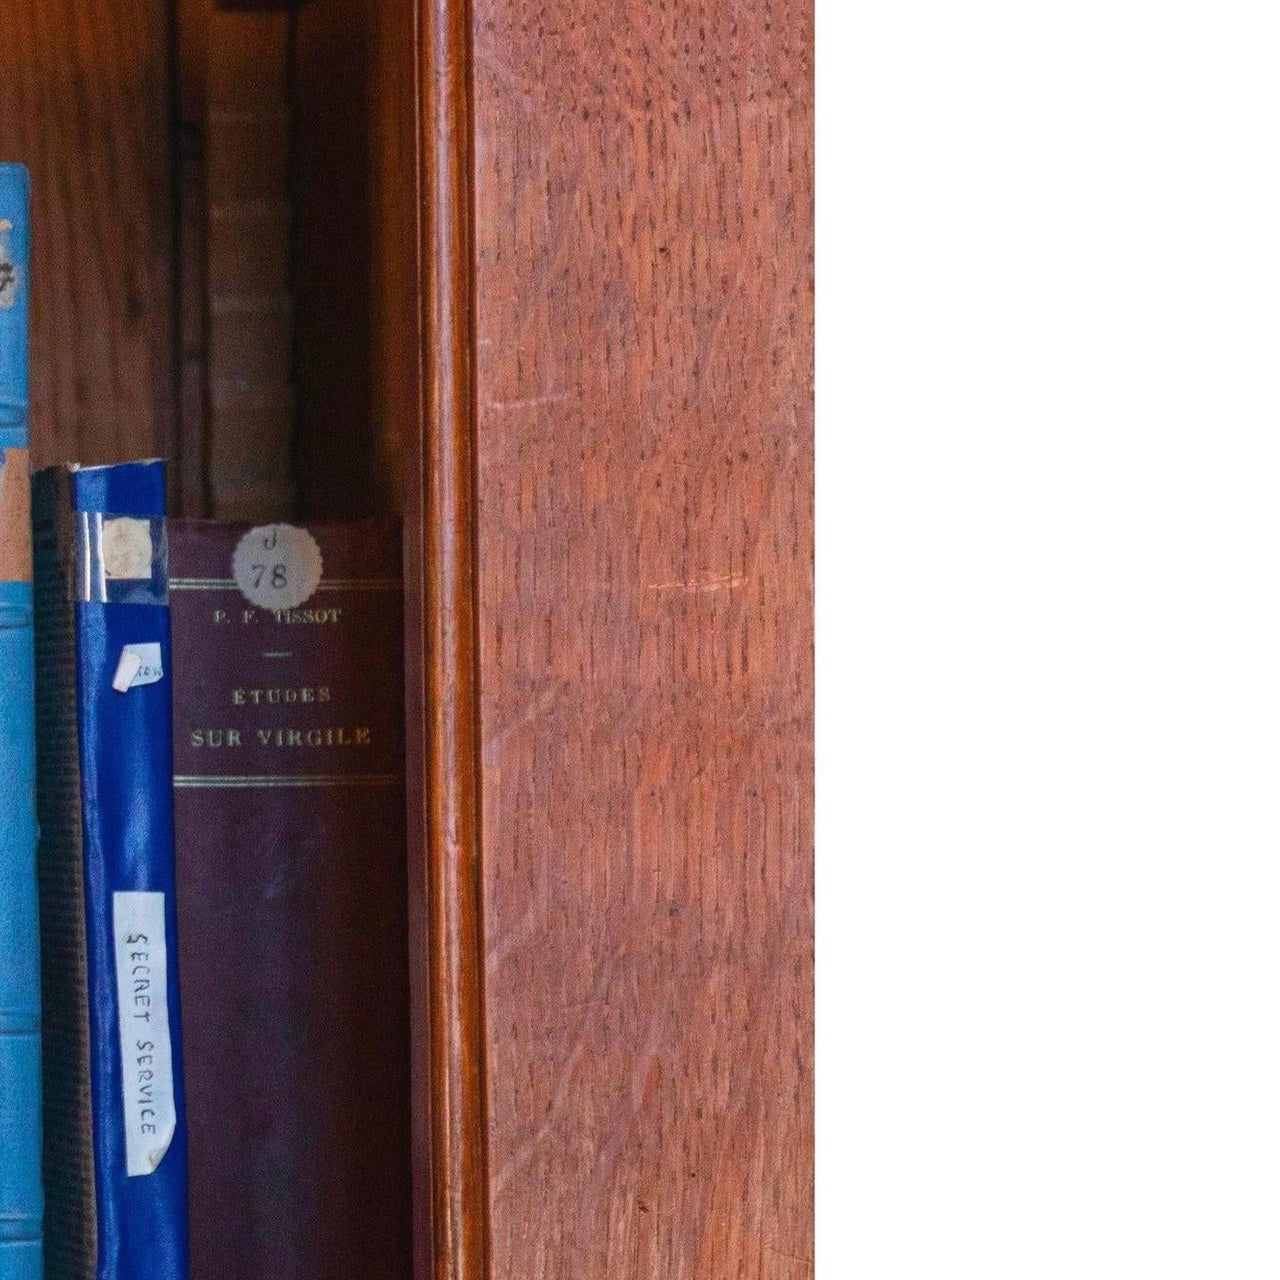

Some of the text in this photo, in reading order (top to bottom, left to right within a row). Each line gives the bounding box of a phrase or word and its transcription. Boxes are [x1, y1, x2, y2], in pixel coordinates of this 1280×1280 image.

[250, 563, 288, 589] 78
[191, 726, 371, 748] SUR VIRGILE
[126, 933, 156, 1135] SECRET SERVICE
